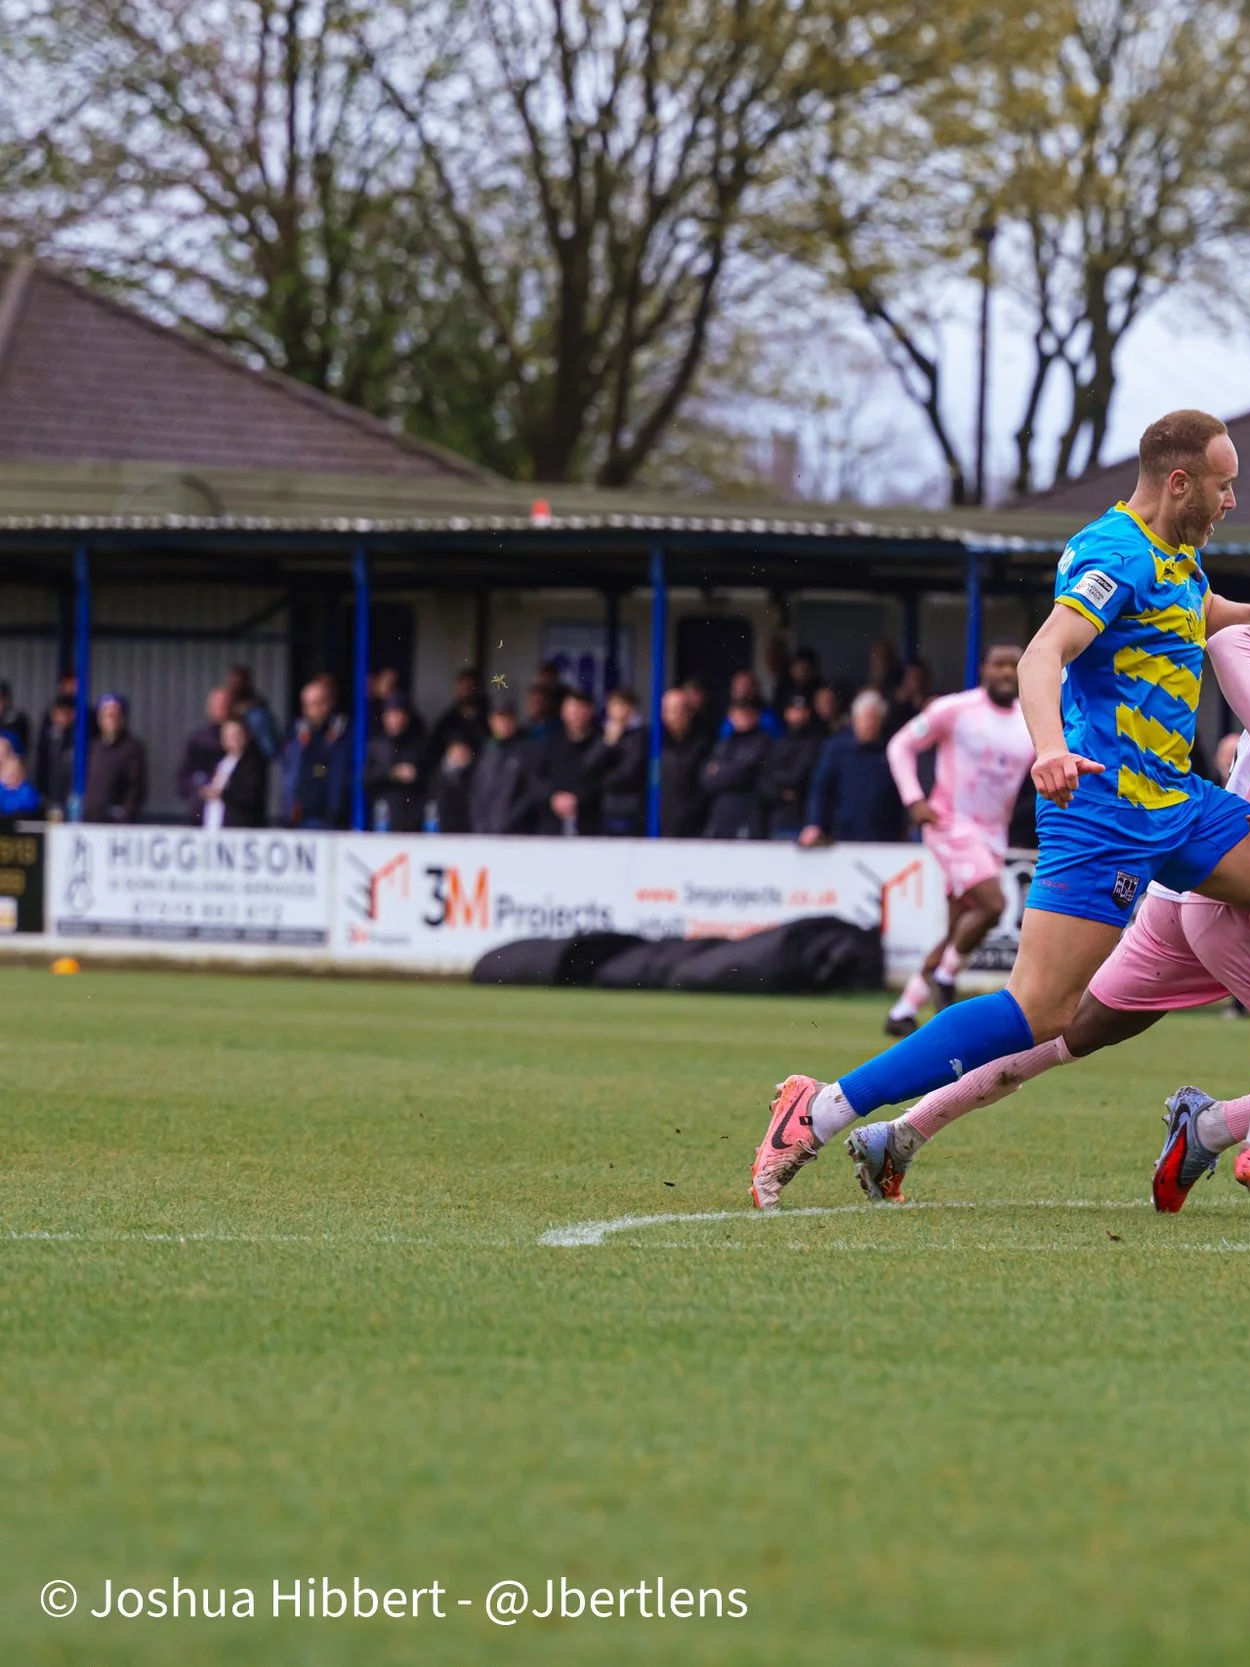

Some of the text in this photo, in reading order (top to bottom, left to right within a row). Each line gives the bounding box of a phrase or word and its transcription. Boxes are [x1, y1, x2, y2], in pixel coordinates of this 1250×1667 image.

[107, 834, 317, 876] HIGGINSON
[422, 864, 490, 930] 3M
[496, 894, 614, 938] Projects
